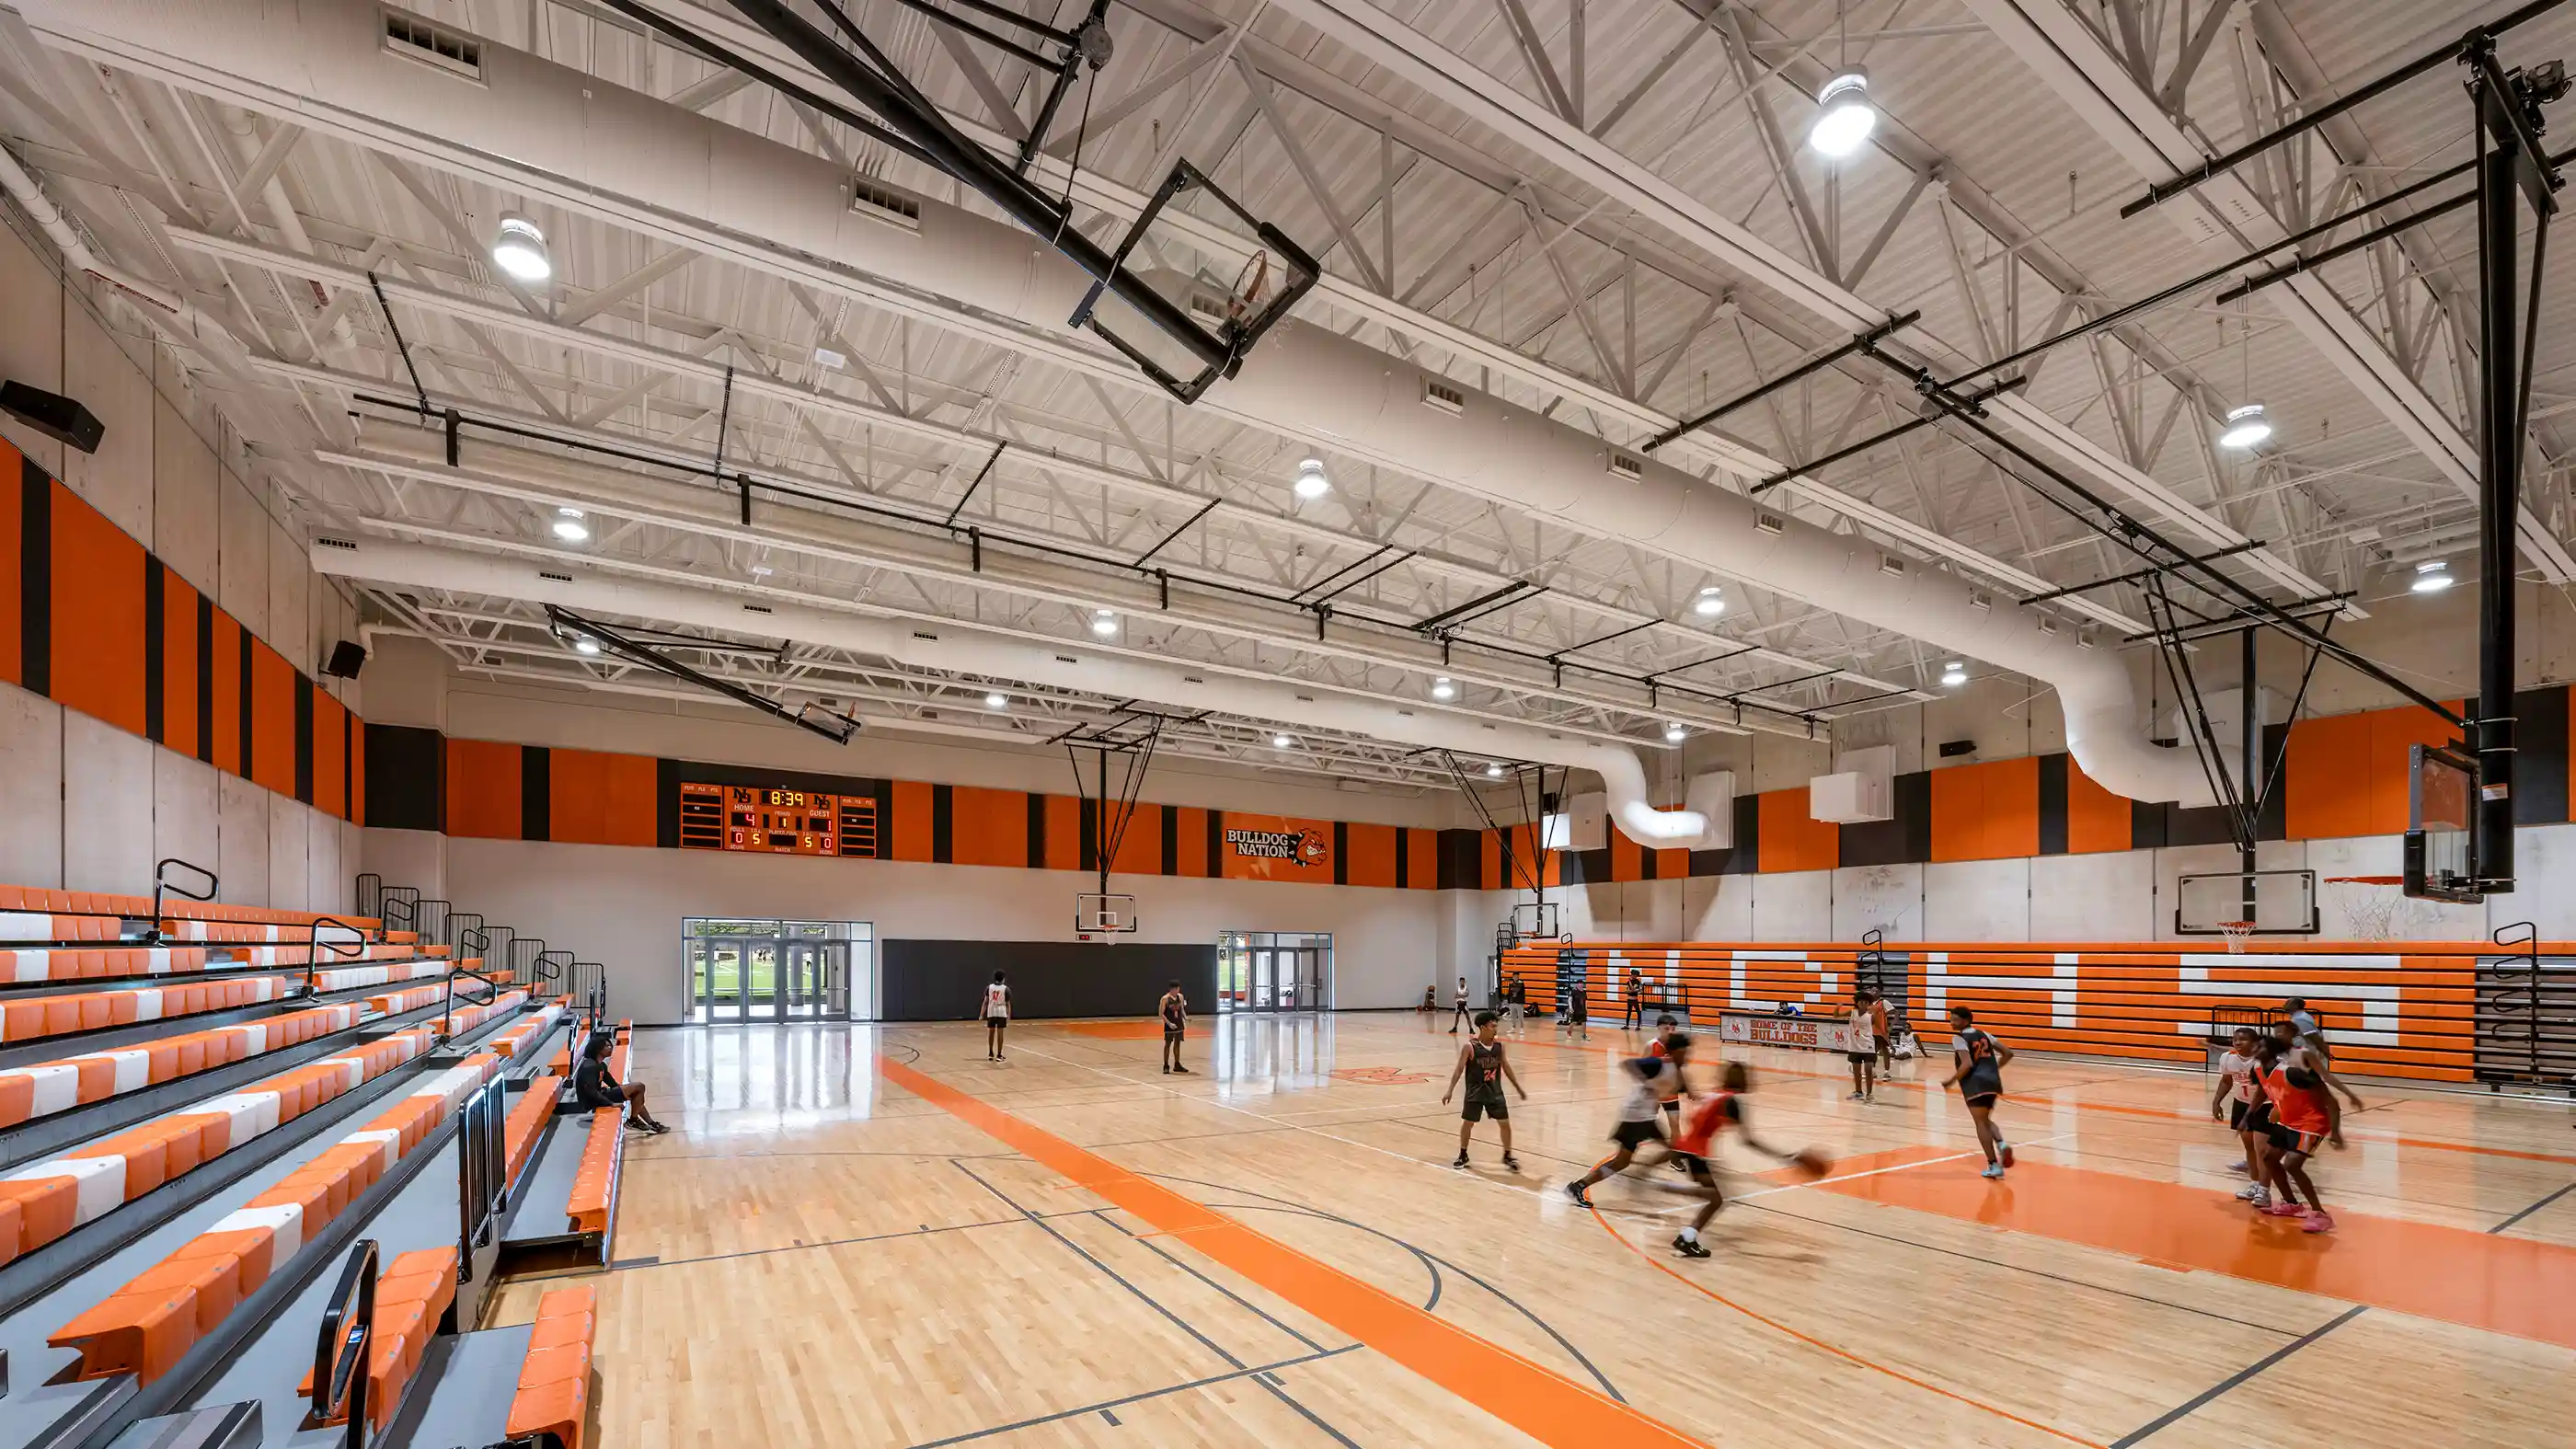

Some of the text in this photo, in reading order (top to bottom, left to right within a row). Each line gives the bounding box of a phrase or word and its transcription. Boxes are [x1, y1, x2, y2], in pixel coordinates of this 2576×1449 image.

[772, 791, 803, 806] 8:39
[734, 803, 754, 812] HOME
[745, 813, 755, 826] 4
[809, 810, 831, 818] GUEST
[783, 817, 787, 828] 1
[828, 820, 832, 832] 1
[736, 832, 743, 844] 0
[753, 833, 761, 845] 5
[805, 836, 812, 848] 5
[824, 837, 832, 849] 0
[1226, 829, 1289, 846] BULLDOG
[1237, 842, 1289, 858] NATION
[1750, 1019, 1818, 1033] HOME OF THE
[1751, 1029, 1817, 1045] BULLDOGS
